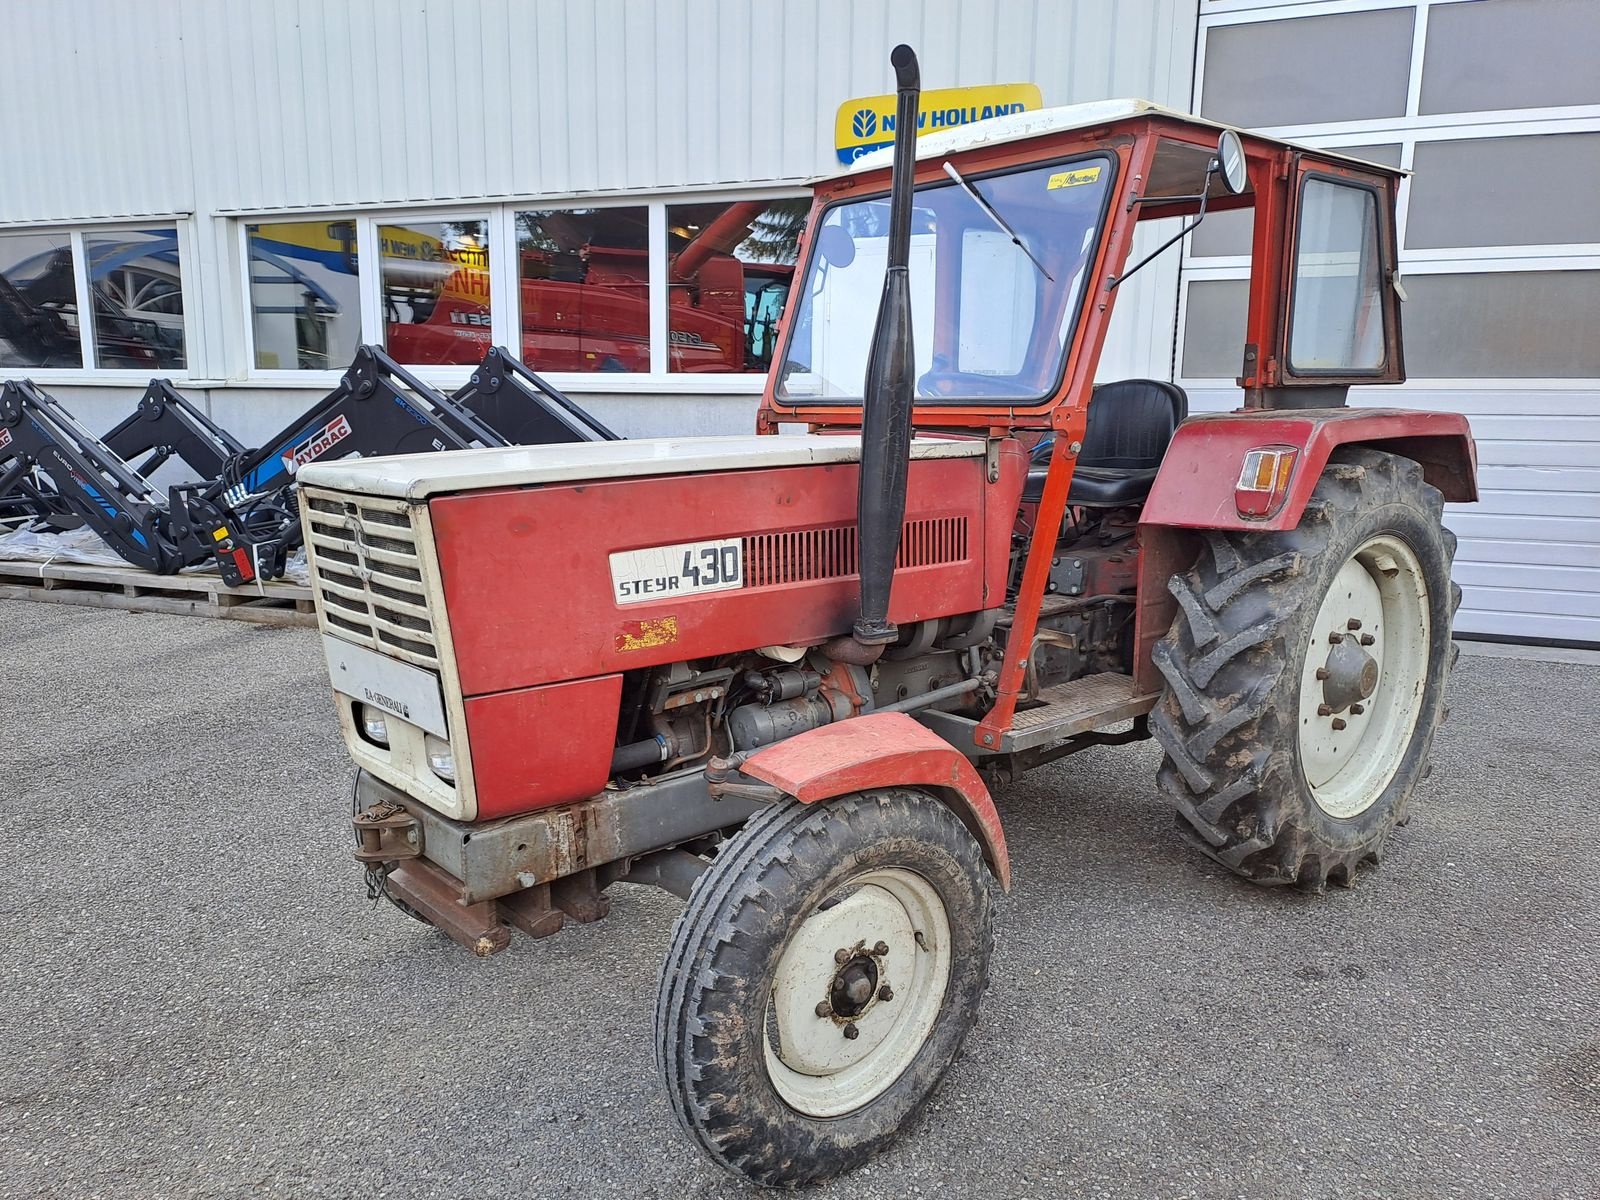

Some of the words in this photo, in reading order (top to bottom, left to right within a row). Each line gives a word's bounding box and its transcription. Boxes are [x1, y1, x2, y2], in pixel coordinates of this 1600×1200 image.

[882, 112, 926, 132] NW
[931, 103, 1025, 128] HOLLAND
[52, 450, 73, 472] EURO
[295, 425, 348, 466] HYDRAC
[619, 576, 679, 597] STEYR
[682, 546, 738, 587] 430
